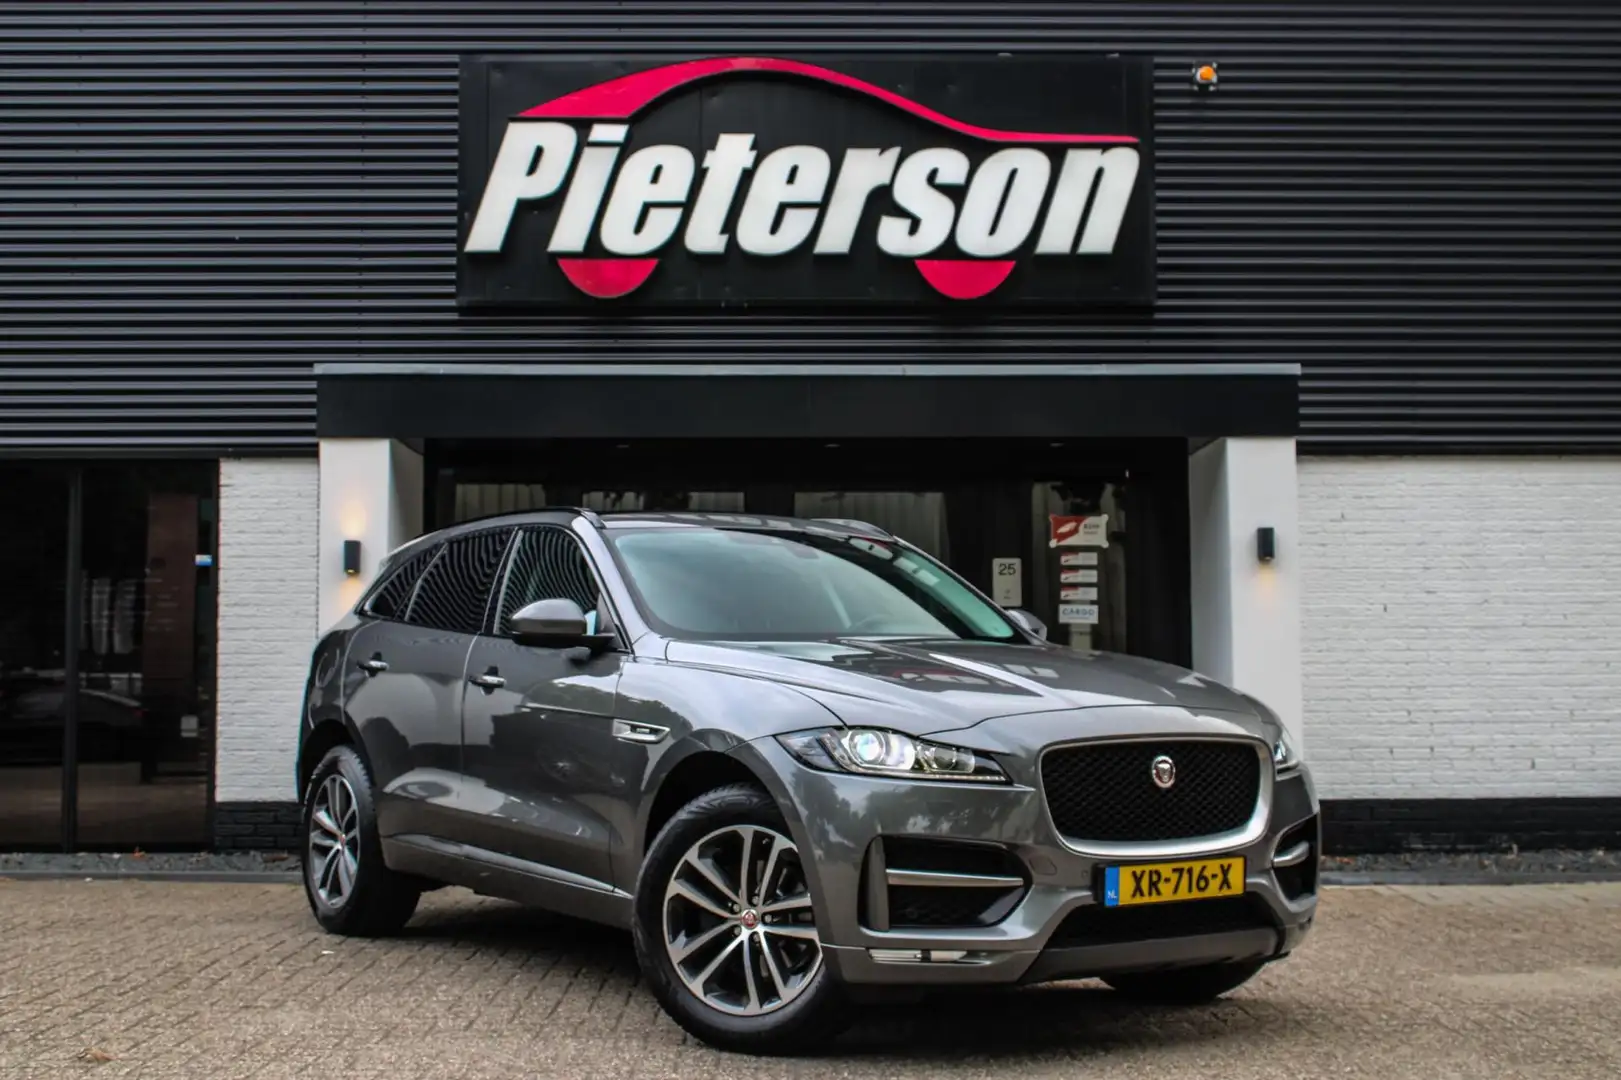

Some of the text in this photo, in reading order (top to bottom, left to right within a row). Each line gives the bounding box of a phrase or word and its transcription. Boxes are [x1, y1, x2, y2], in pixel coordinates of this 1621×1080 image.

[464, 121, 1140, 255] Pieterson
[998, 563, 1017, 576] 25
[1131, 864, 1232, 898] XR-716-X
[1107, 890, 1118, 898] NL
